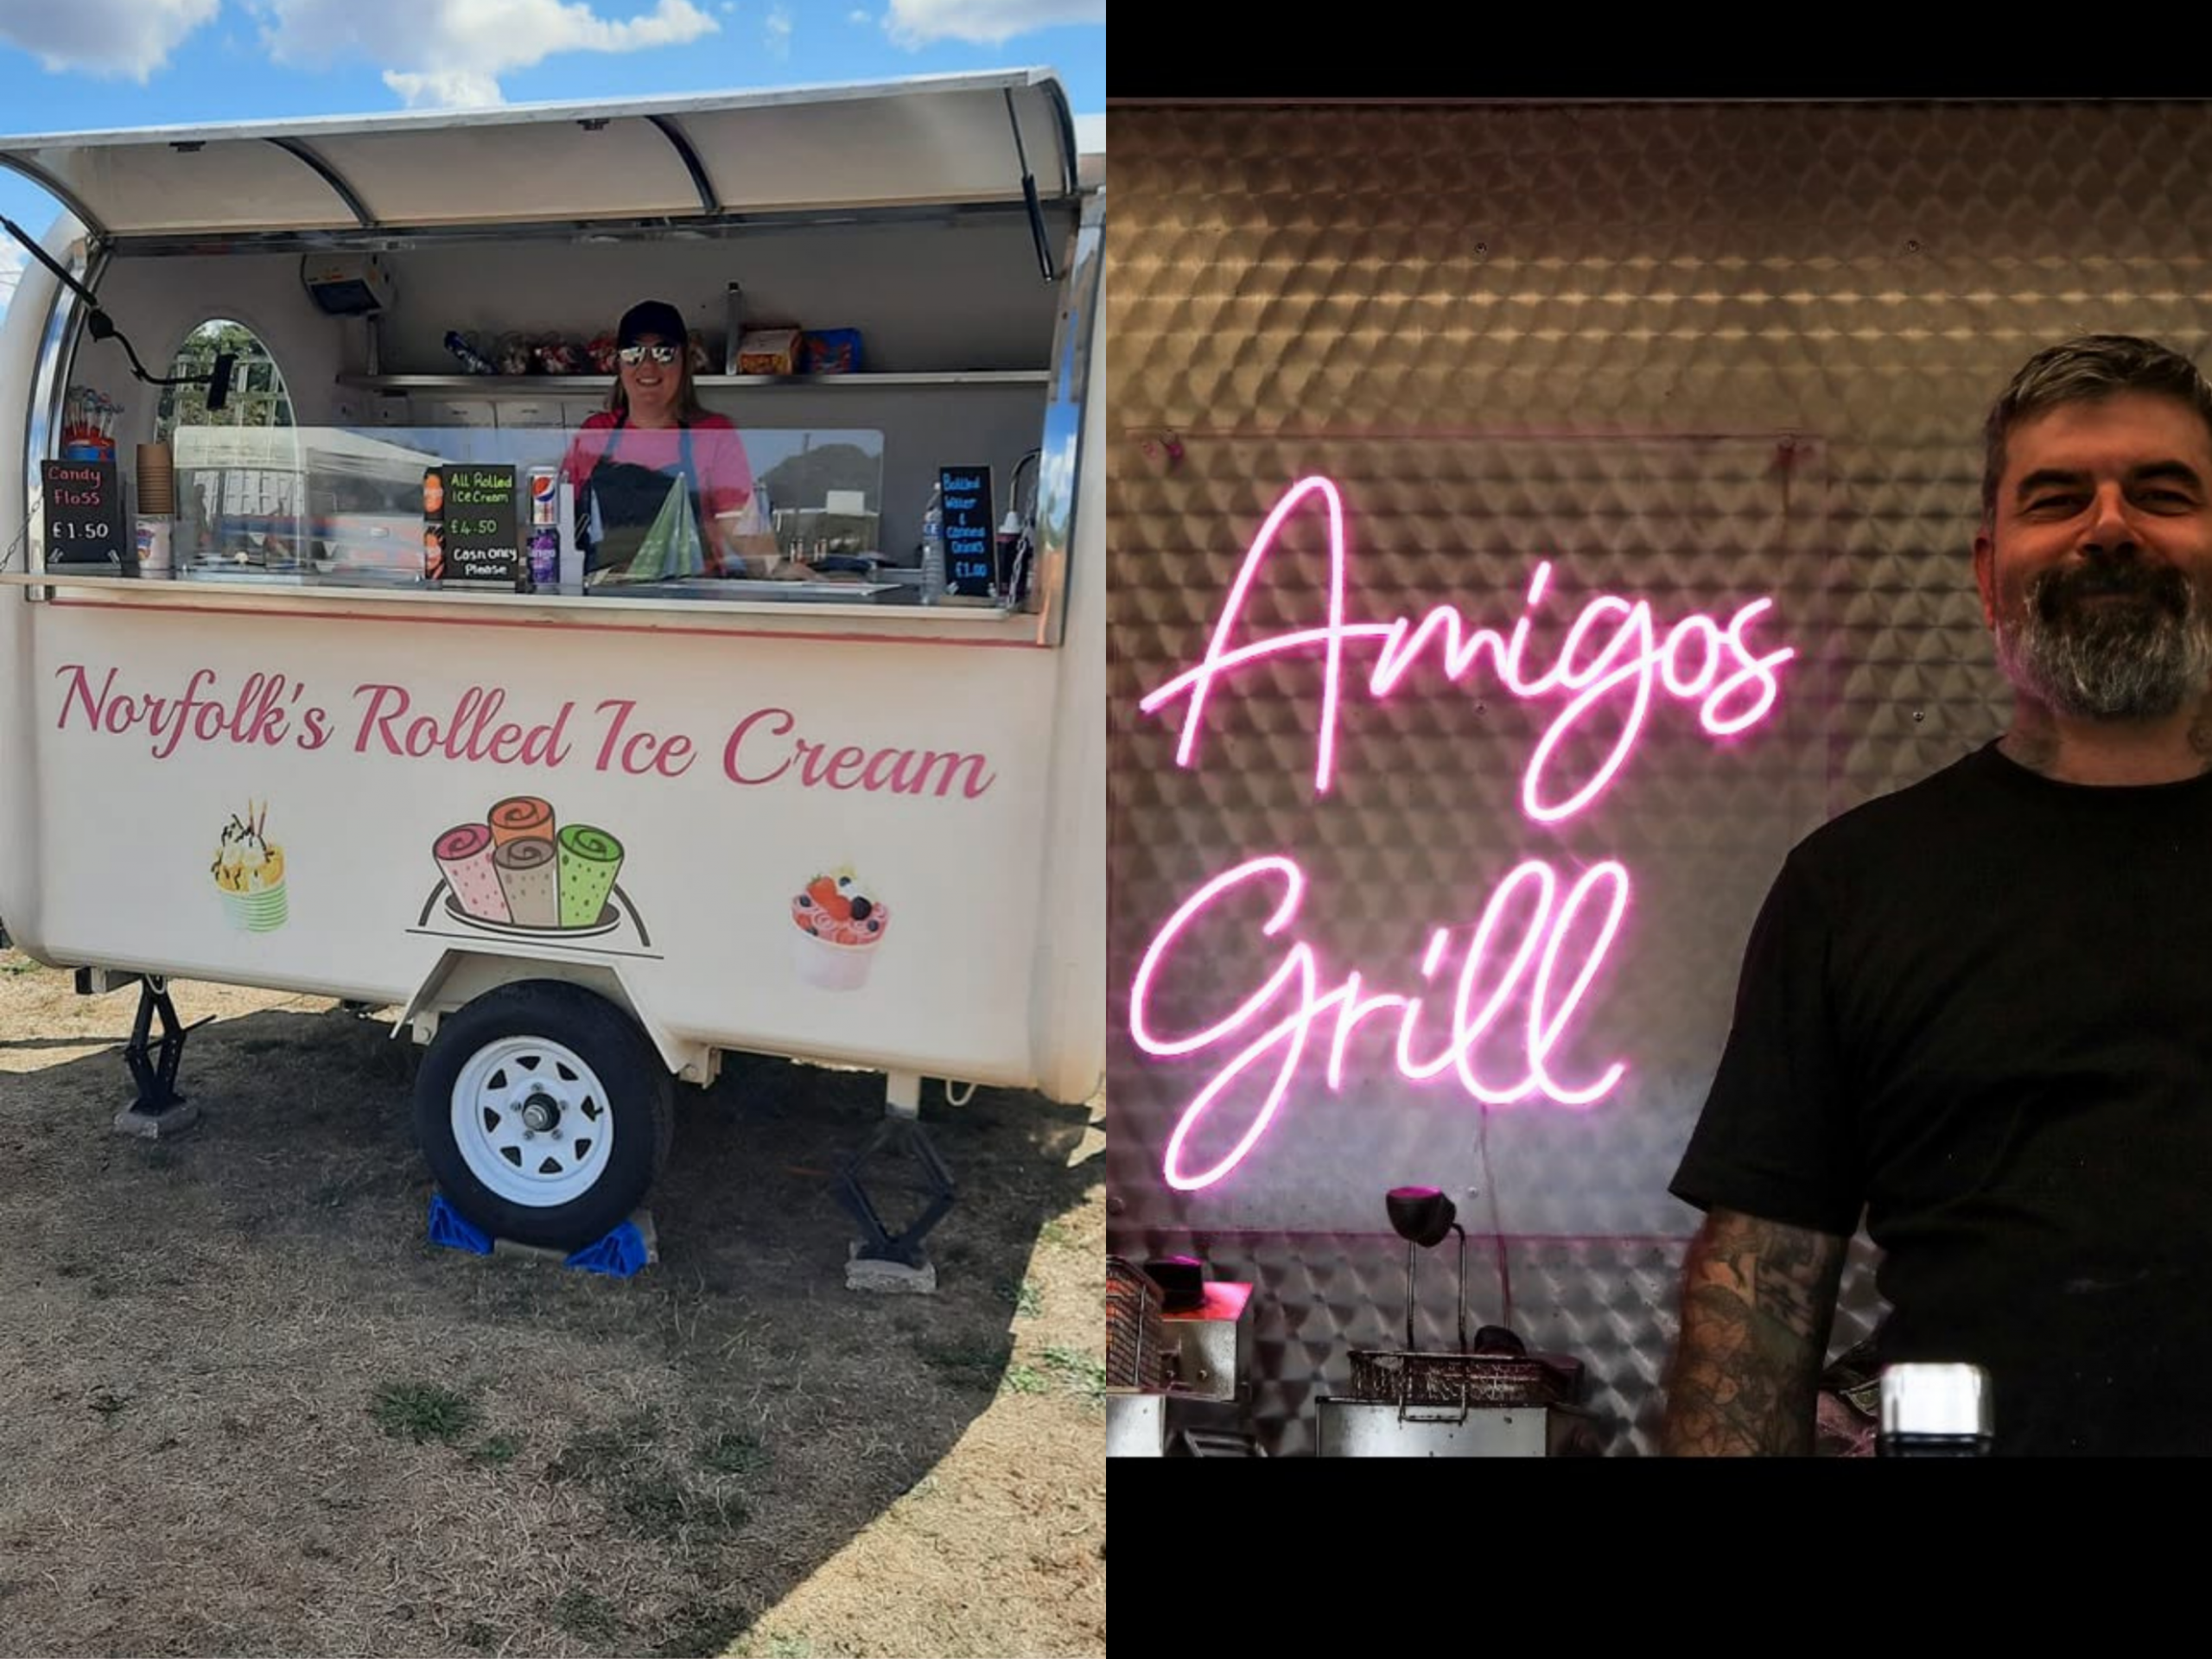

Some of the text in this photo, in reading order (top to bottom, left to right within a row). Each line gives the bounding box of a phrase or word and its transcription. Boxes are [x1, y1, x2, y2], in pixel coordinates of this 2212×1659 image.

[48, 467, 101, 488] Candy
[450, 472, 512, 488] All Rolled
[54, 489, 101, 505] Floss
[473, 491, 509, 503] Cream
[454, 548, 486, 562] Cash
[465, 563, 507, 576] Please
[1140, 475, 1795, 822] Amigos
[55, 664, 995, 798] Norfolk's Rolled Ice Cream
[1129, 856, 1629, 1192] Grill
